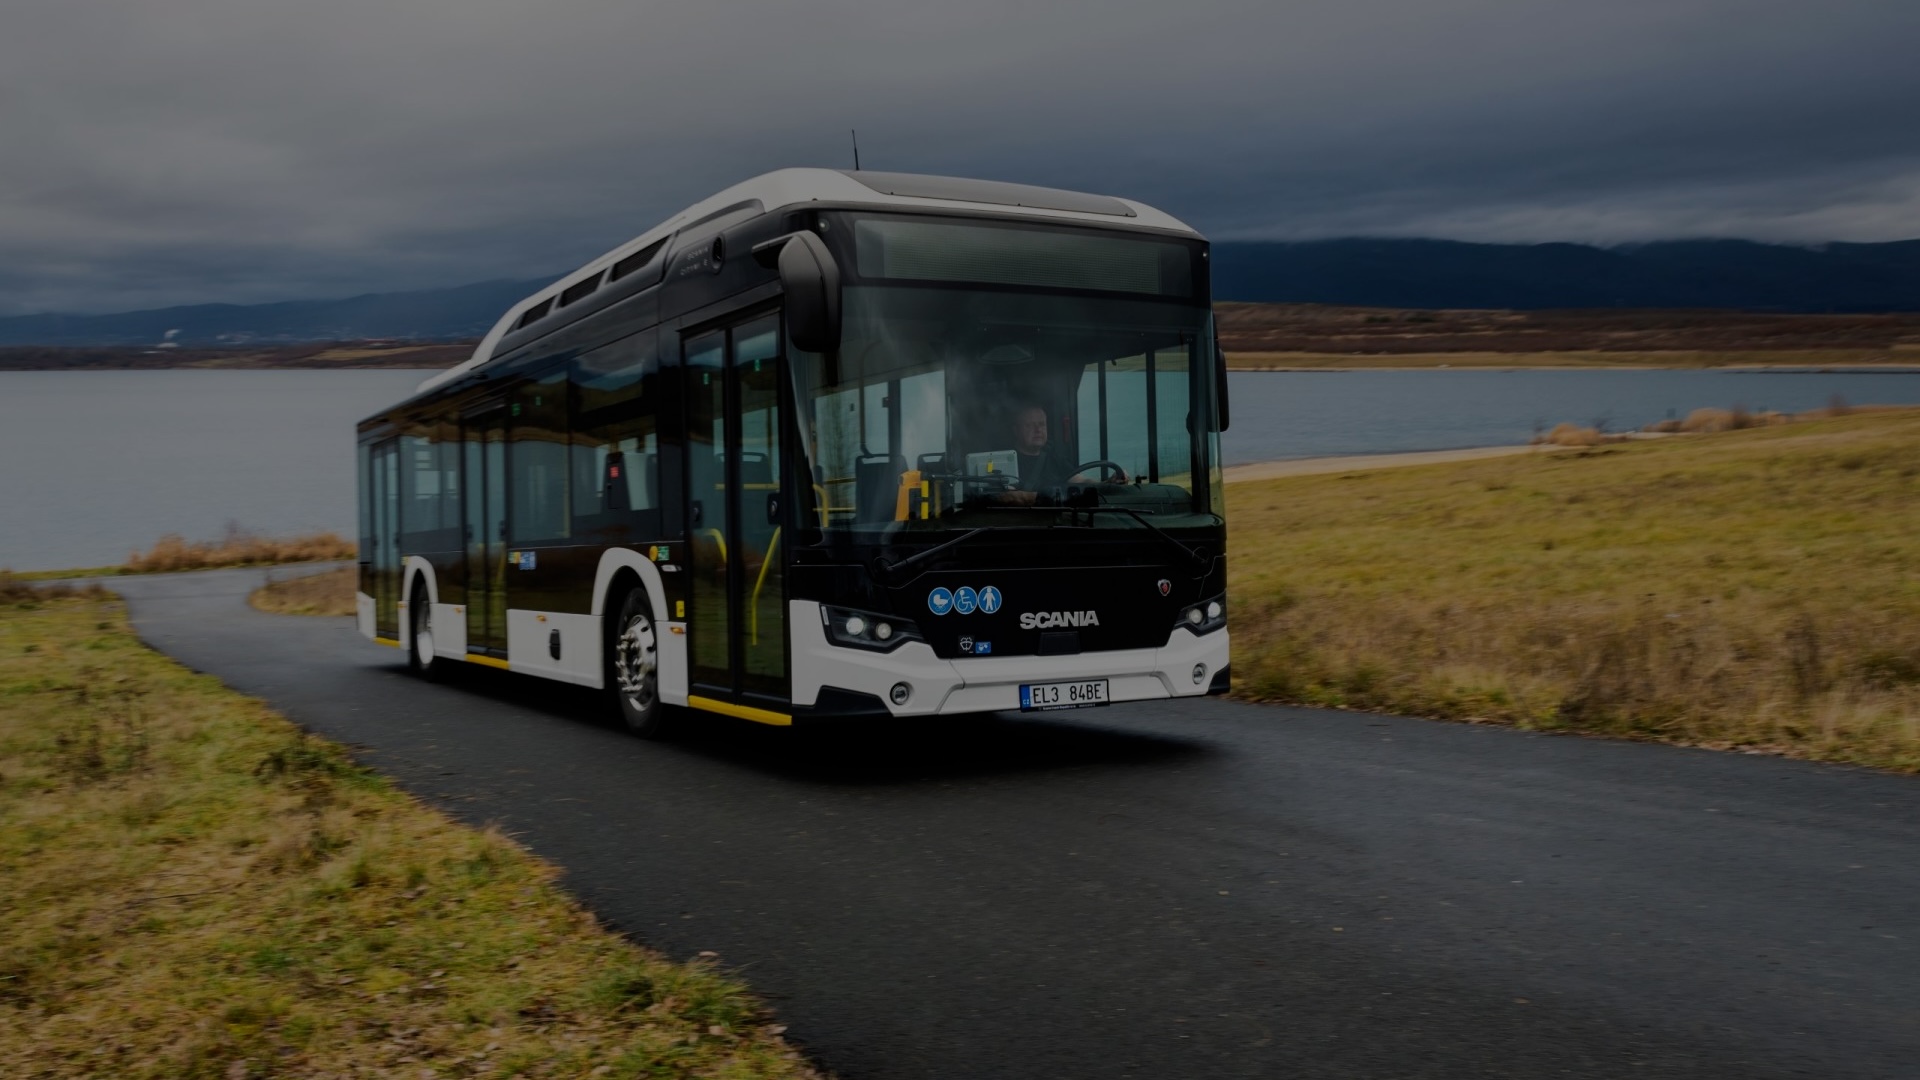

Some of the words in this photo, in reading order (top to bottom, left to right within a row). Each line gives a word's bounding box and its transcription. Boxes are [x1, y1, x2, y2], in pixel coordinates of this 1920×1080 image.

[1019, 610, 1100, 630] SCANIA
[1033, 687, 1059, 704] EL3
[1069, 683, 1102, 701] 84BE
